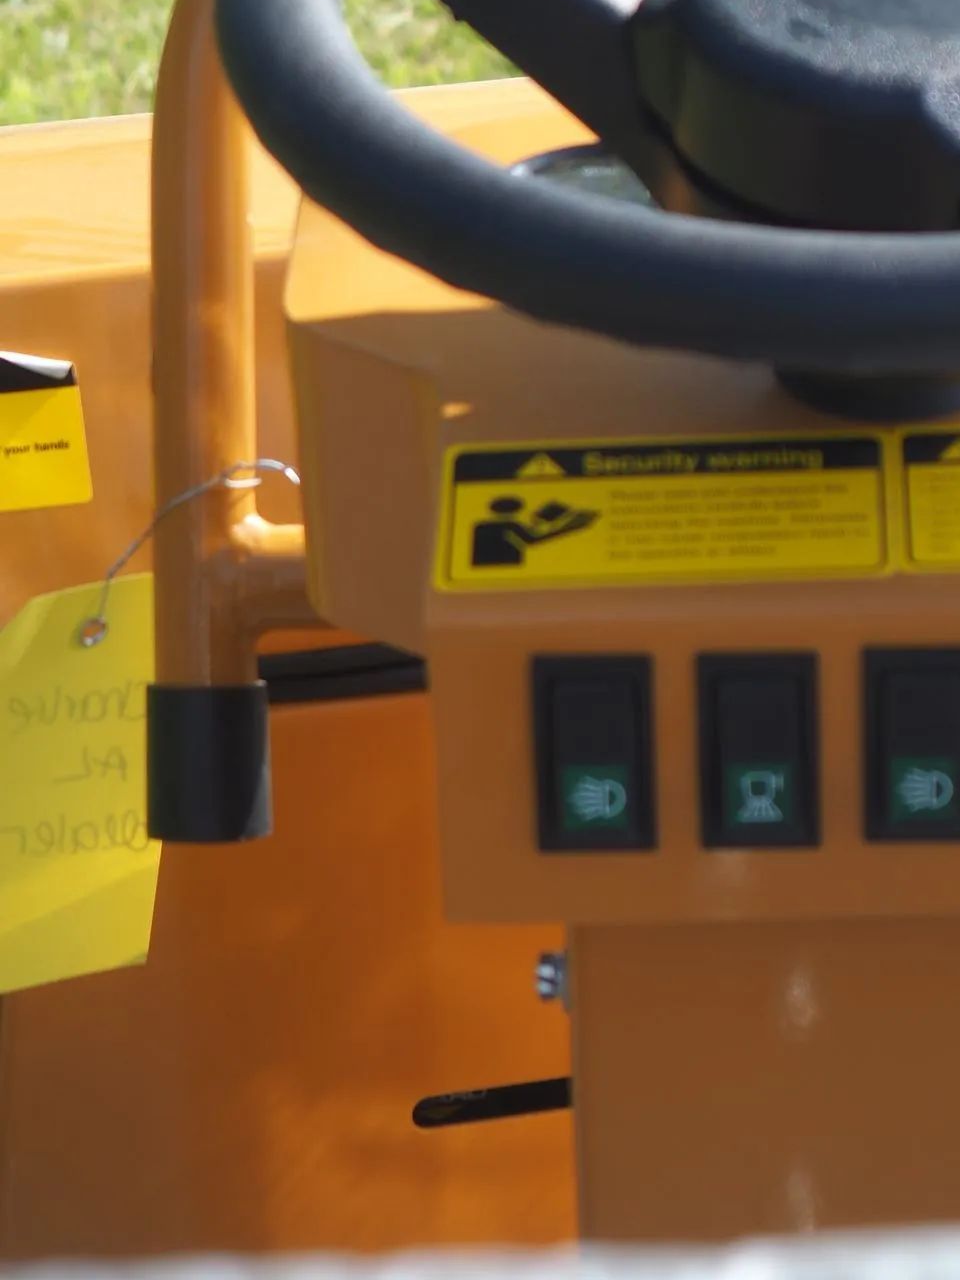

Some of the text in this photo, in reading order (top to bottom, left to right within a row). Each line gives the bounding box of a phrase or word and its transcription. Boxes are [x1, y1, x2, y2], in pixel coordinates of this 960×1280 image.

[3, 439, 71, 459] your hands
[582, 448, 825, 477] Security warning
